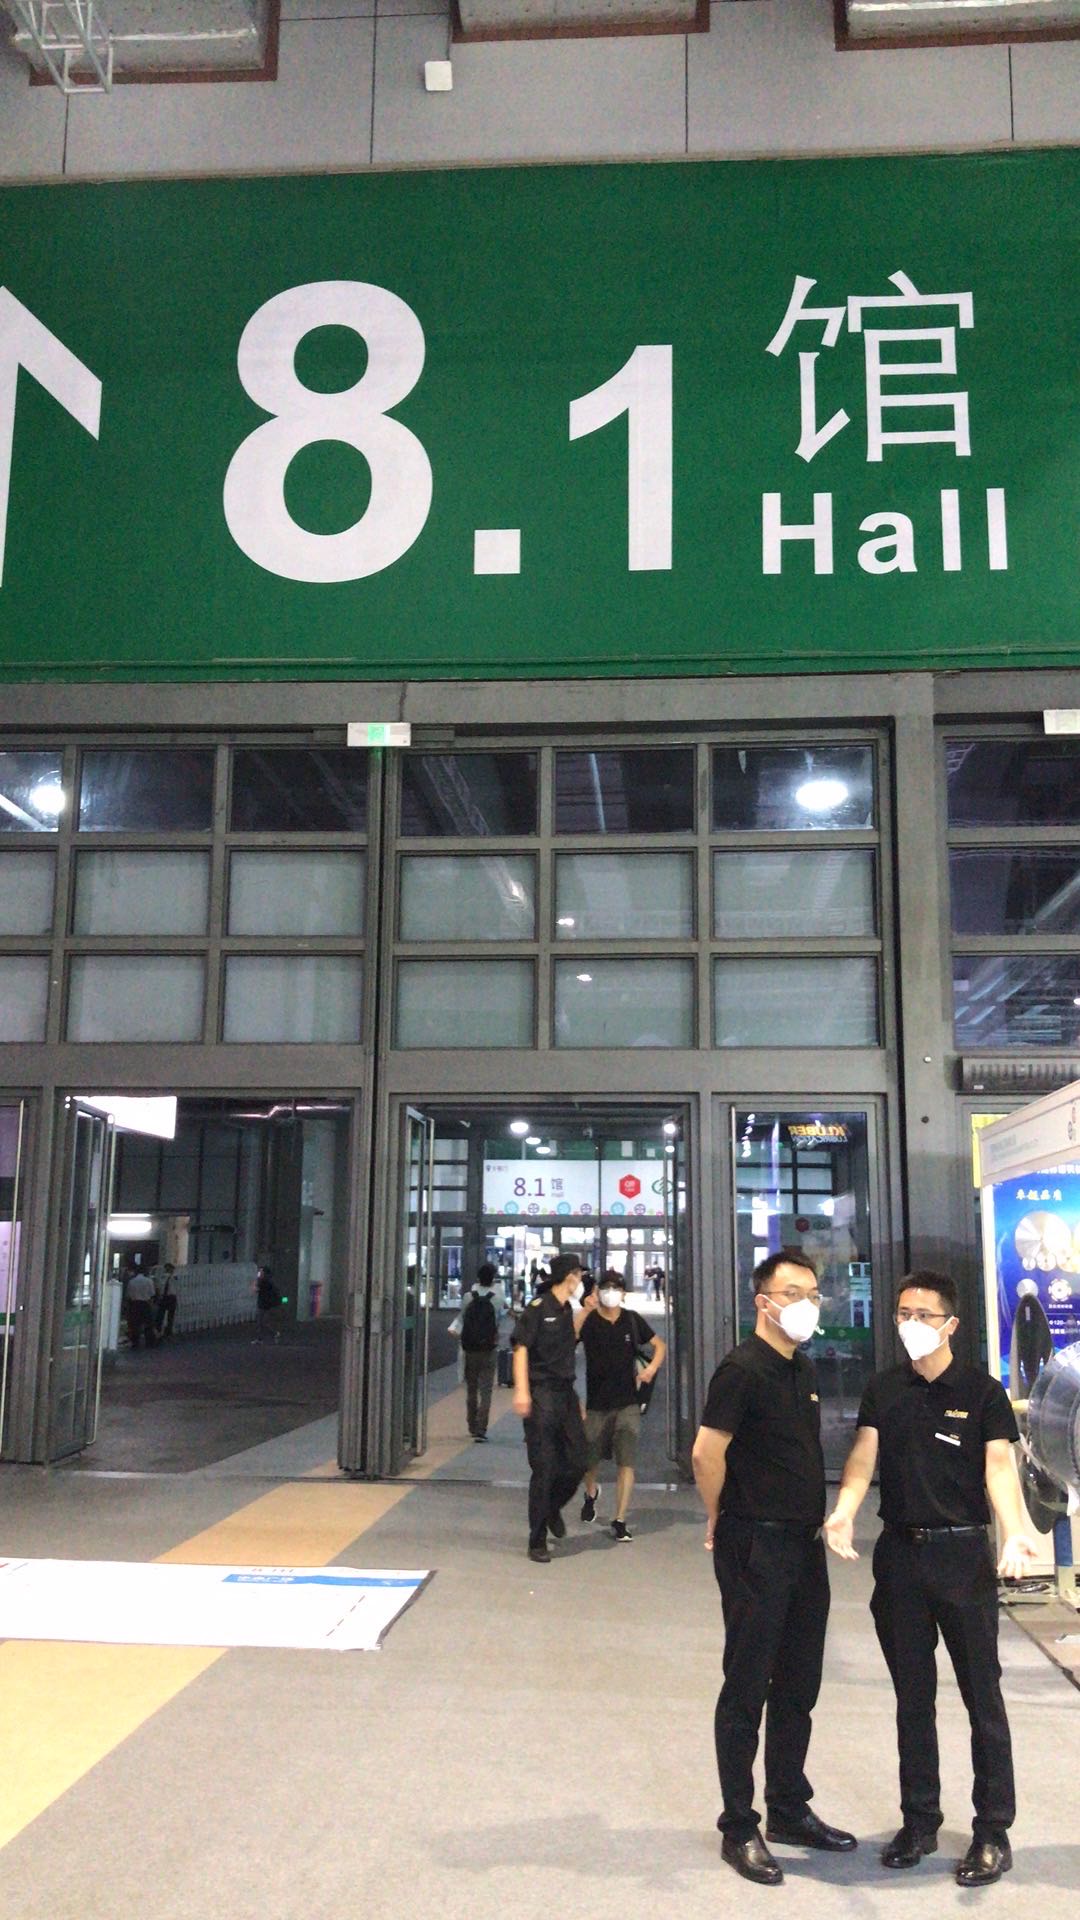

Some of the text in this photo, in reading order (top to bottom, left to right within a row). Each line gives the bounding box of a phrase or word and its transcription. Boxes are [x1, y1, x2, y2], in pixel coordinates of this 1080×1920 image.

[223, 271, 974, 583] 8.1 馆
[763, 488, 1009, 575] Hall
[513, 1177, 546, 1197] 8.1
